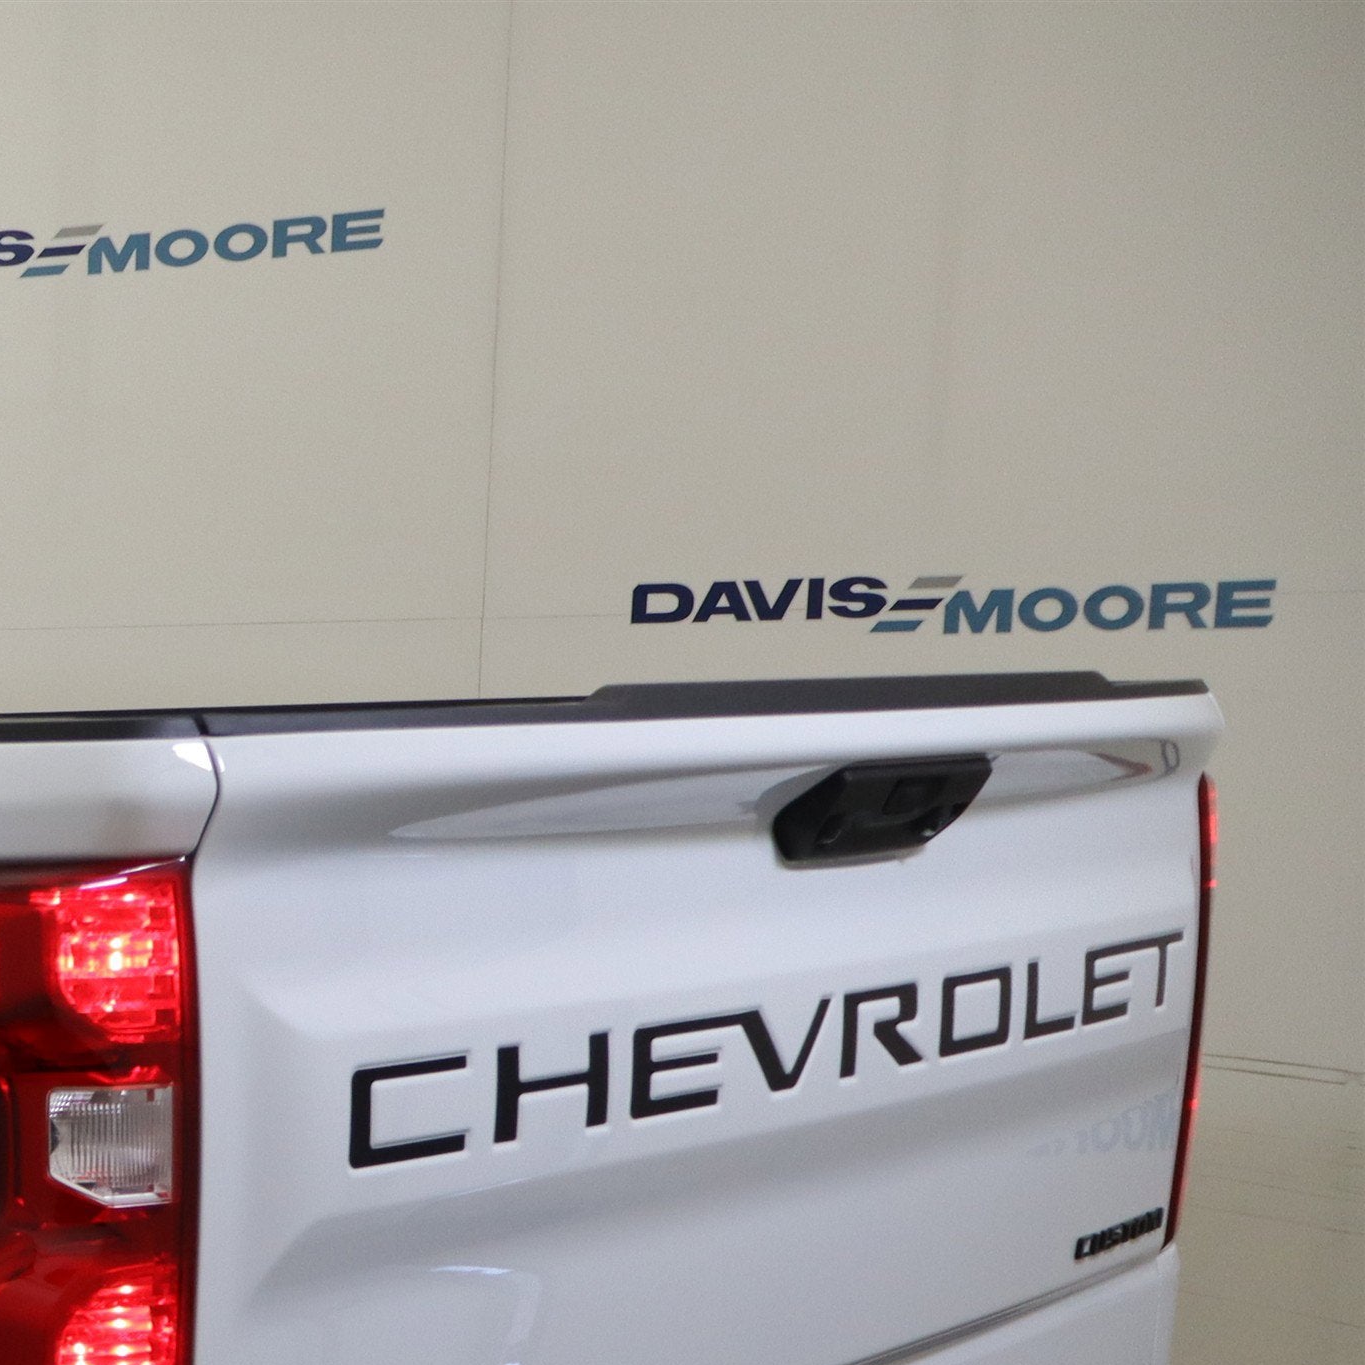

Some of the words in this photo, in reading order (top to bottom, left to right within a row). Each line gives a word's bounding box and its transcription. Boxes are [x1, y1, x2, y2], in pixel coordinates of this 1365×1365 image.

[86, 208, 387, 276] MOORE
[630, 576, 889, 625] DAVIS
[942, 579, 1278, 635] MOORE
[348, 929, 1185, 1170] CHEVROLET
